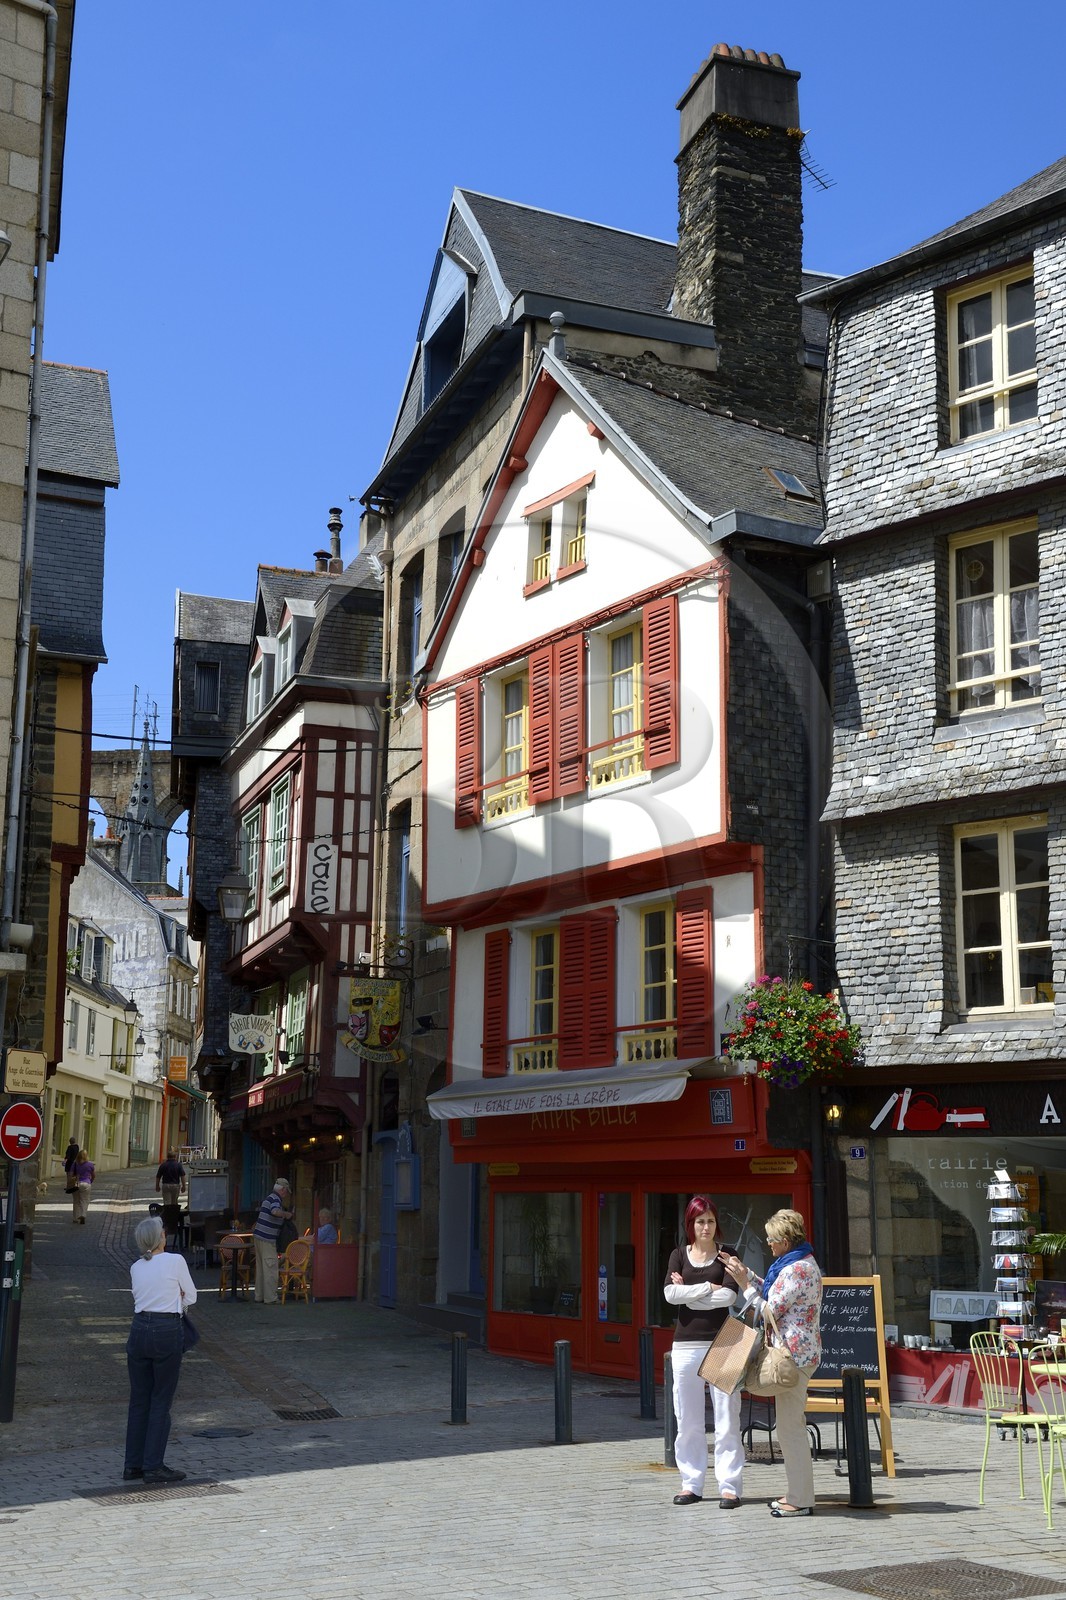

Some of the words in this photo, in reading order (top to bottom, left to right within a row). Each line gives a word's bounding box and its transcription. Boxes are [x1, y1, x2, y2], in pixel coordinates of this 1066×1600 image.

[23, 1056, 31, 1065] Rue
[8, 1066, 18, 1075] Ange
[19, 1066, 25, 1075] de
[12, 1078, 20, 1087] Voie
[473, 1101, 482, 1114] IL
[485, 1098, 513, 1112] ETAIT
[513, 1096, 536, 1110] UNE
[539, 1093, 562, 1108] FOIS
[566, 1092, 580, 1106] LA
[583, 1086, 621, 1104] CRÊPE
[825, 1288, 856, 1298] LETTRE
[858, 1286, 873, 1297] THÉ
[936, 1297, 998, 1316] MAMA
